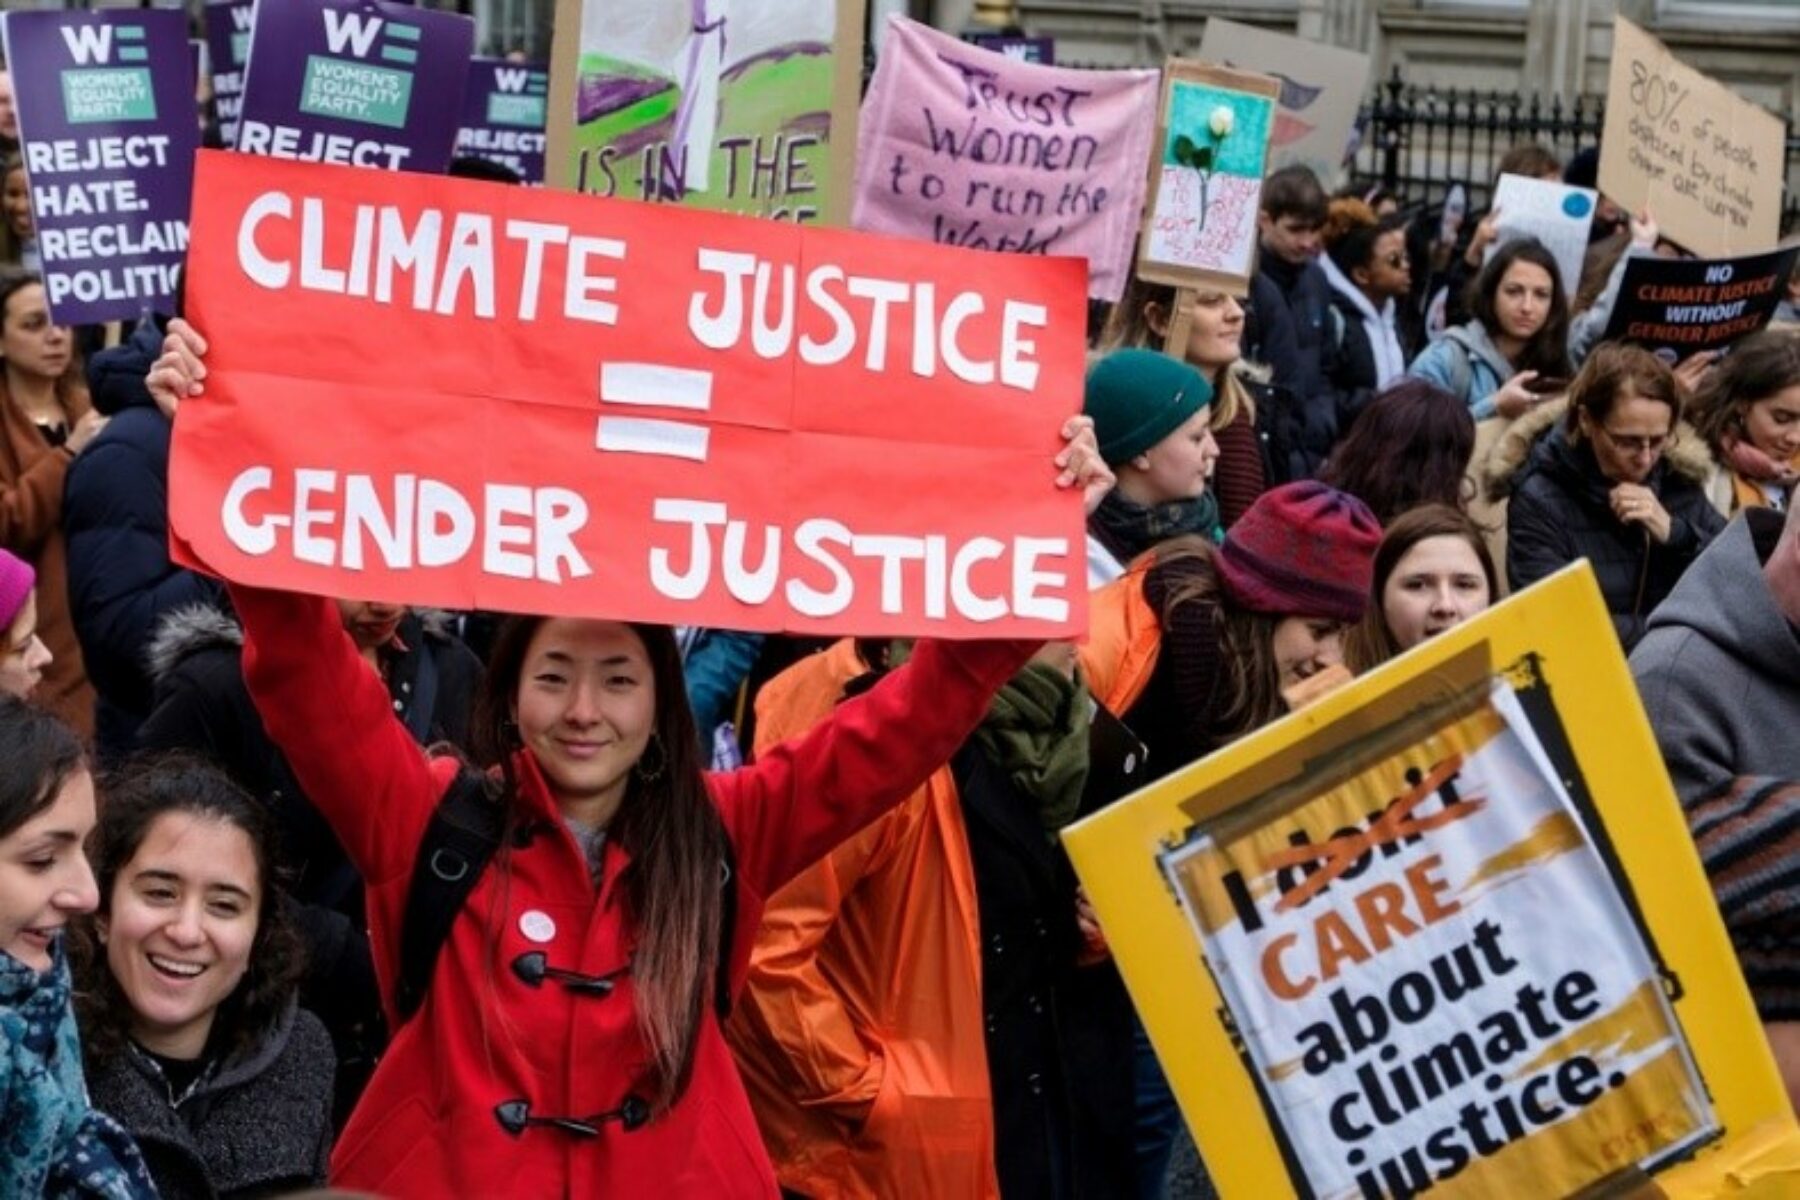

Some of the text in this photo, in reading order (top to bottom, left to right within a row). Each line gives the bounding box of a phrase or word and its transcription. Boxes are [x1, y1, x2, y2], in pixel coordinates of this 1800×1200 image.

[310, 77, 402, 106] EQUALITY
[313, 62, 400, 91] WOMEN'S
[1630, 60, 1690, 133] 80%
[27, 135, 170, 174] REJECT
[238, 121, 411, 172] REJECT
[458, 127, 546, 153] REJECT
[718, 133, 818, 200] THE
[34, 180, 149, 218] HATE.
[889, 154, 1108, 217] to run the
[237, 191, 1049, 391] CLIMATE JUSTICE
[1638, 283, 1713, 303] CLIMATE
[1705, 264, 1734, 284] NO
[1628, 321, 1703, 343] GENDER
[1665, 300, 1748, 324] WITHOUT
[221, 465, 1069, 623] GENDER JUSTICE
[1222, 870, 1263, 934] I
[1259, 854, 1462, 1002] CARE
[1295, 919, 1519, 1077] about
[1329, 970, 1601, 1142] climate
[1347, 1055, 1626, 1200] justice.
